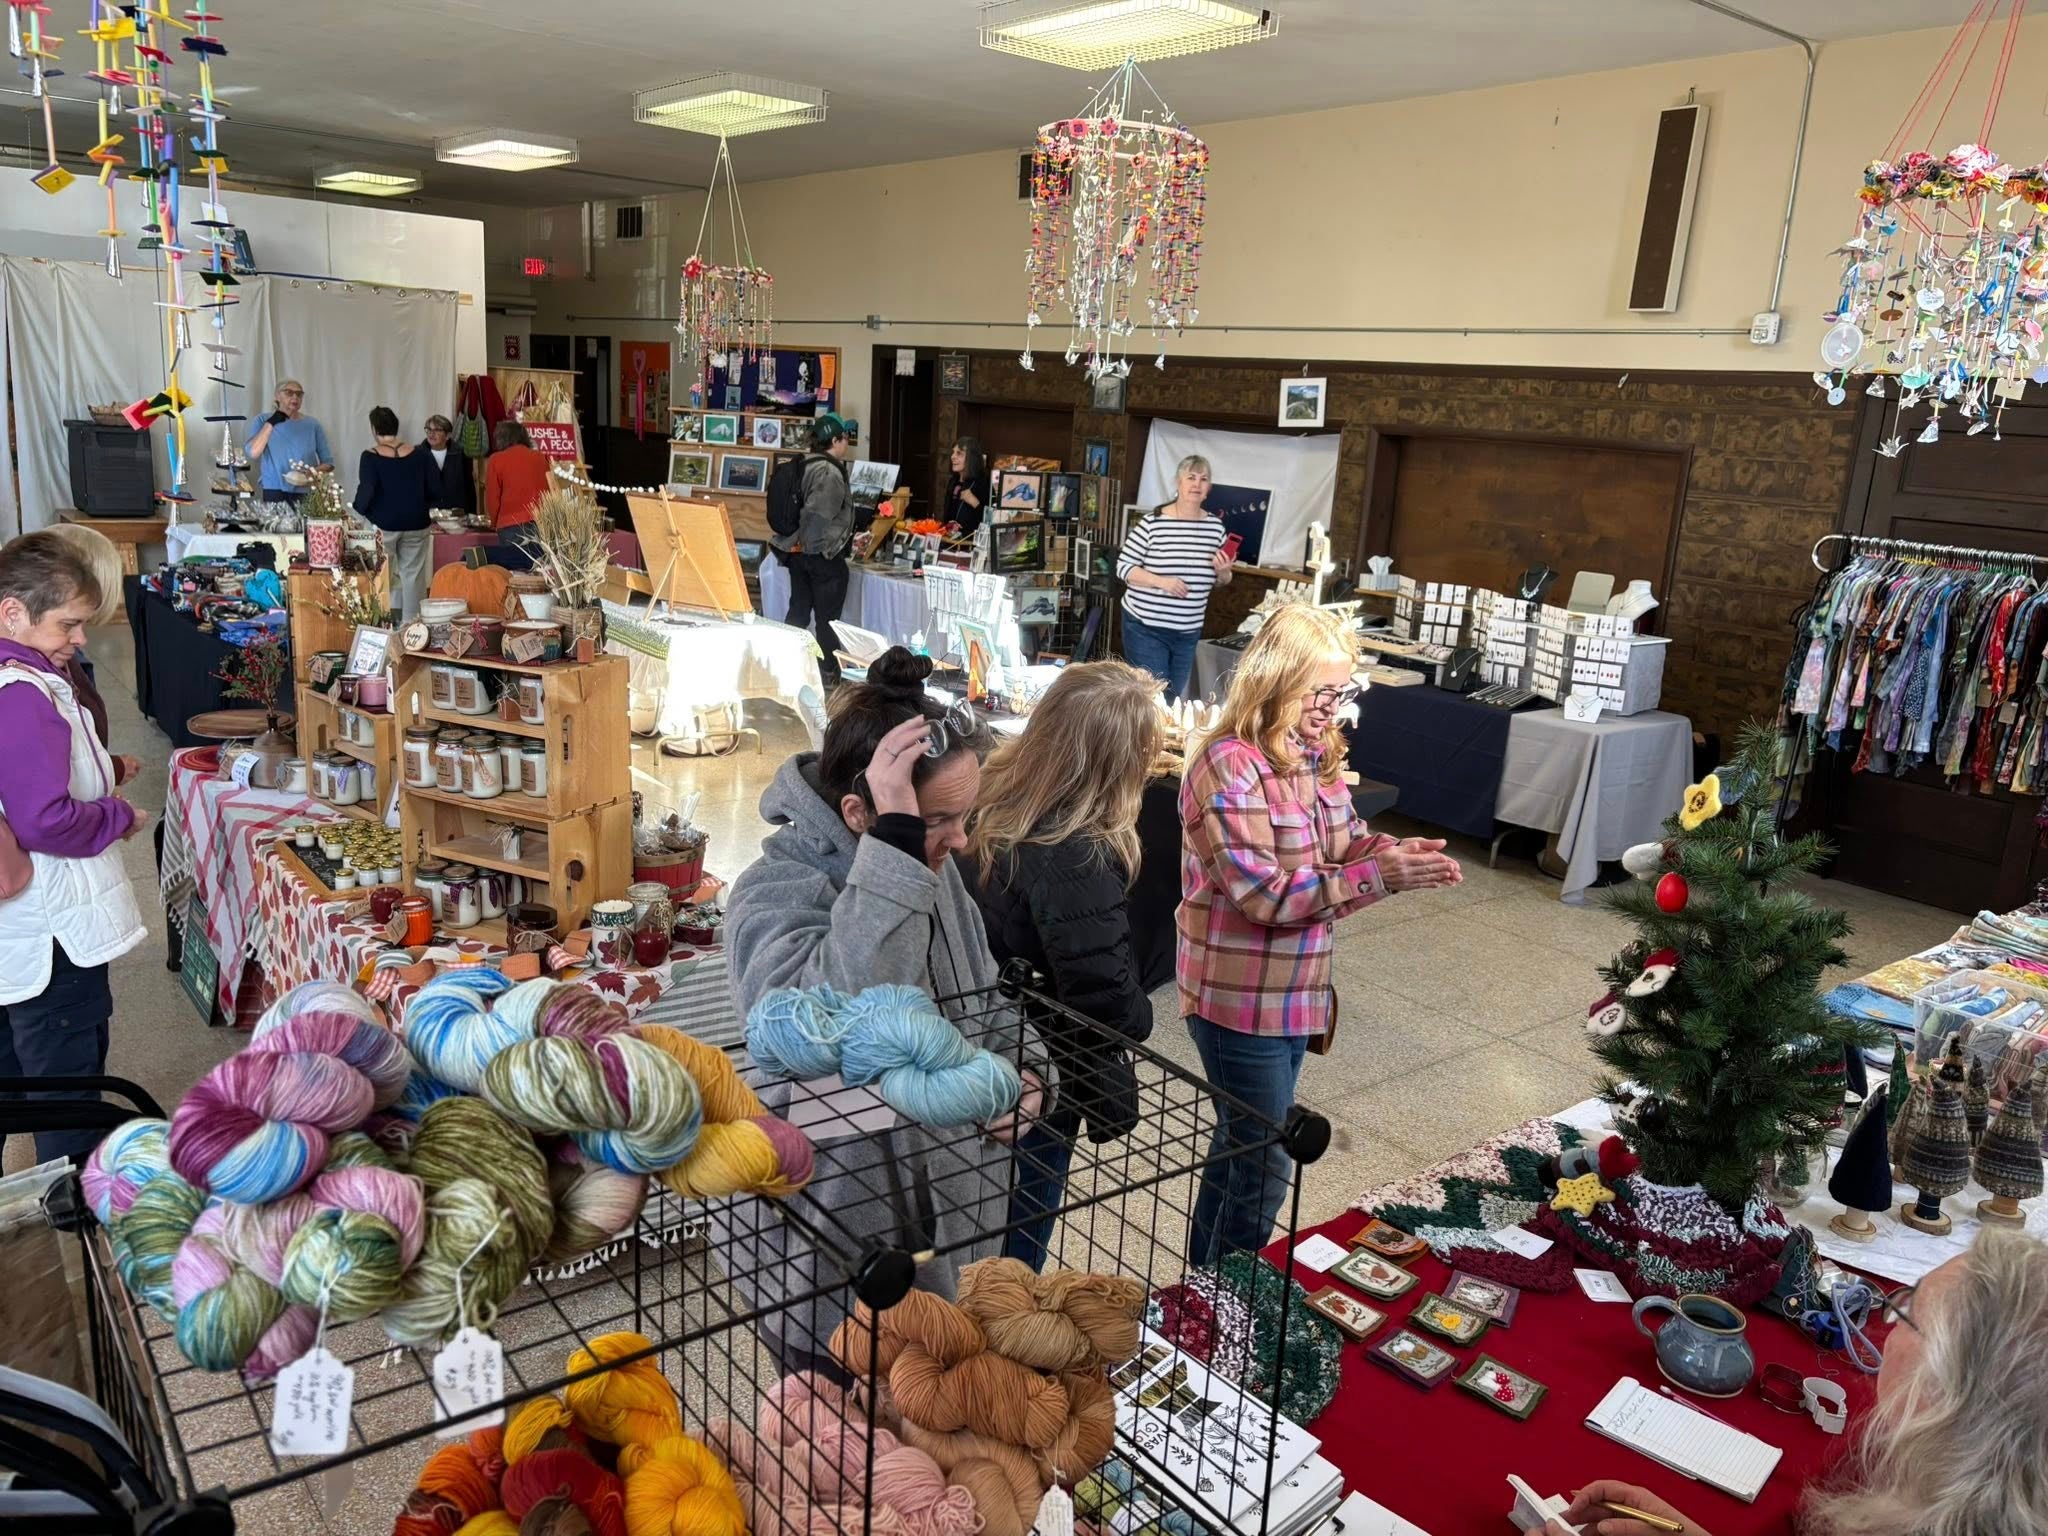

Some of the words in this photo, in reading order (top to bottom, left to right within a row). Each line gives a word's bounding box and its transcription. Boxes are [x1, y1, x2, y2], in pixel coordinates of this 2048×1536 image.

[527, 427, 561, 439] USHEL
[540, 440, 548, 450] A
[550, 440, 575, 451] PECK
